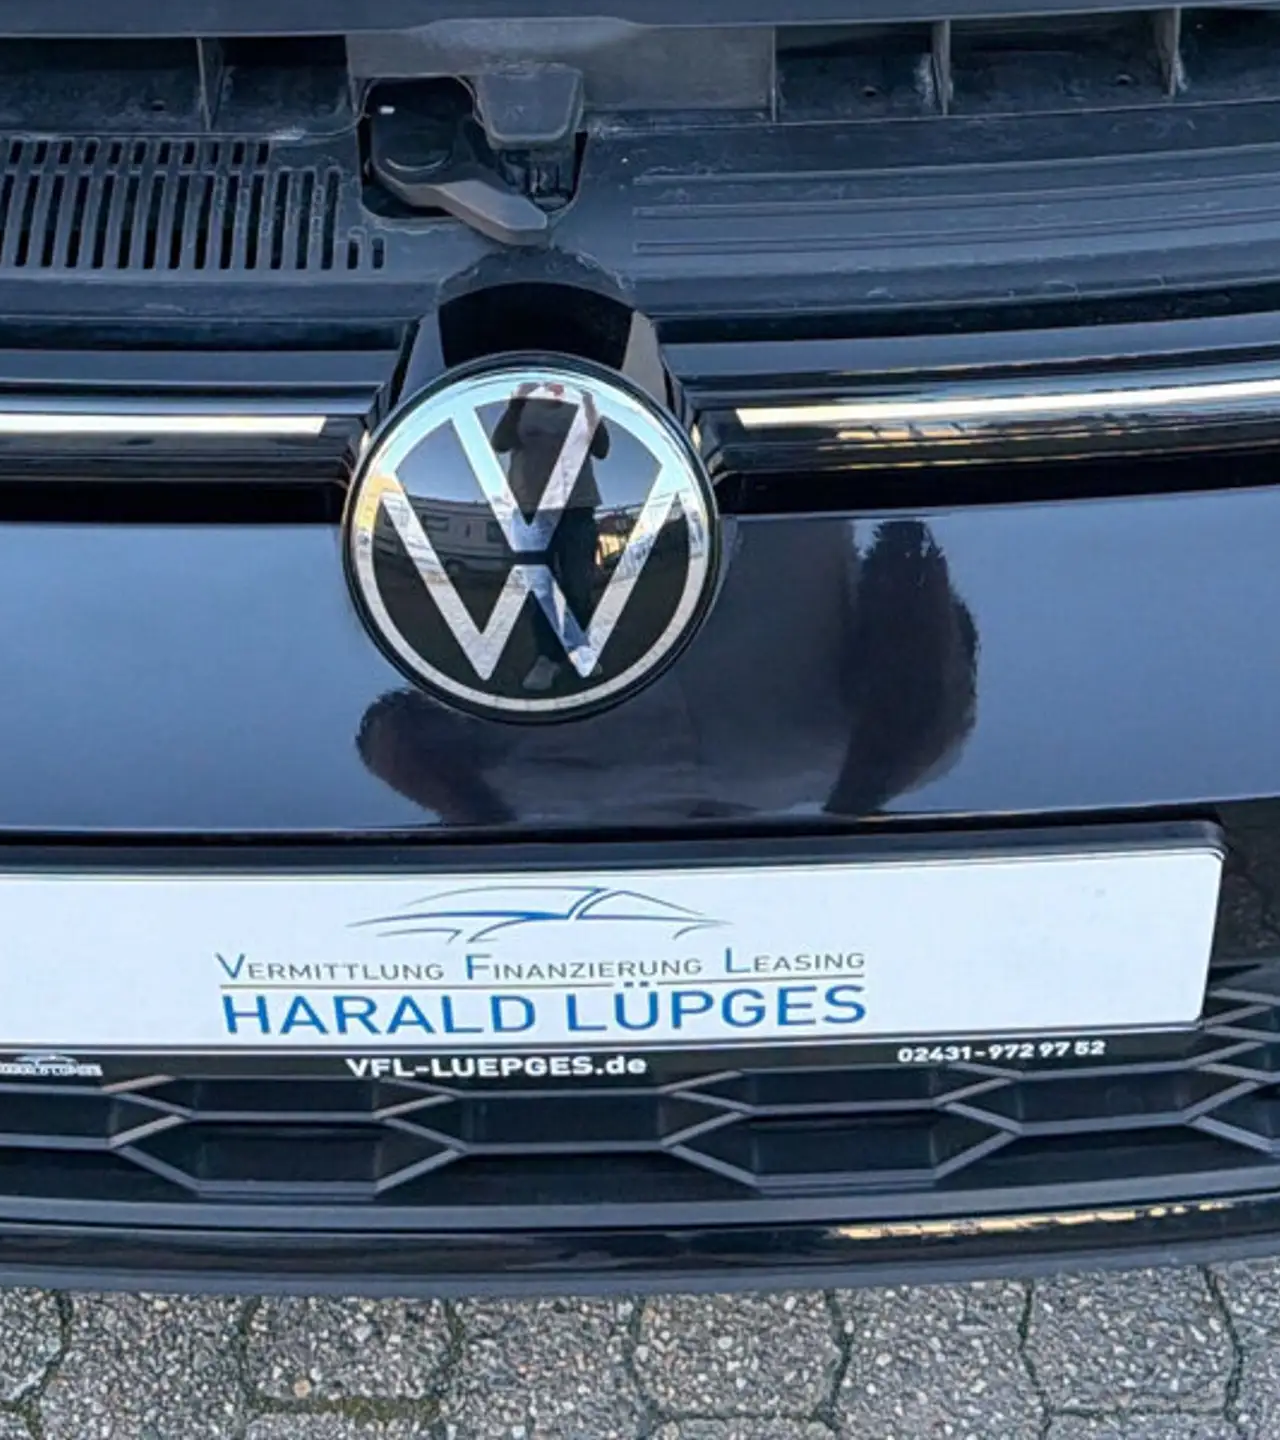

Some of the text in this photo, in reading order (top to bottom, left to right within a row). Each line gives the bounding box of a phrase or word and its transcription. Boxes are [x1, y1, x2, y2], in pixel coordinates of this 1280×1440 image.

[370, 382, 698, 685] VW
[221, 980, 867, 1035] HARALD LÜPGES
[345, 1055, 647, 1078] VFL-LUEPGES.de
